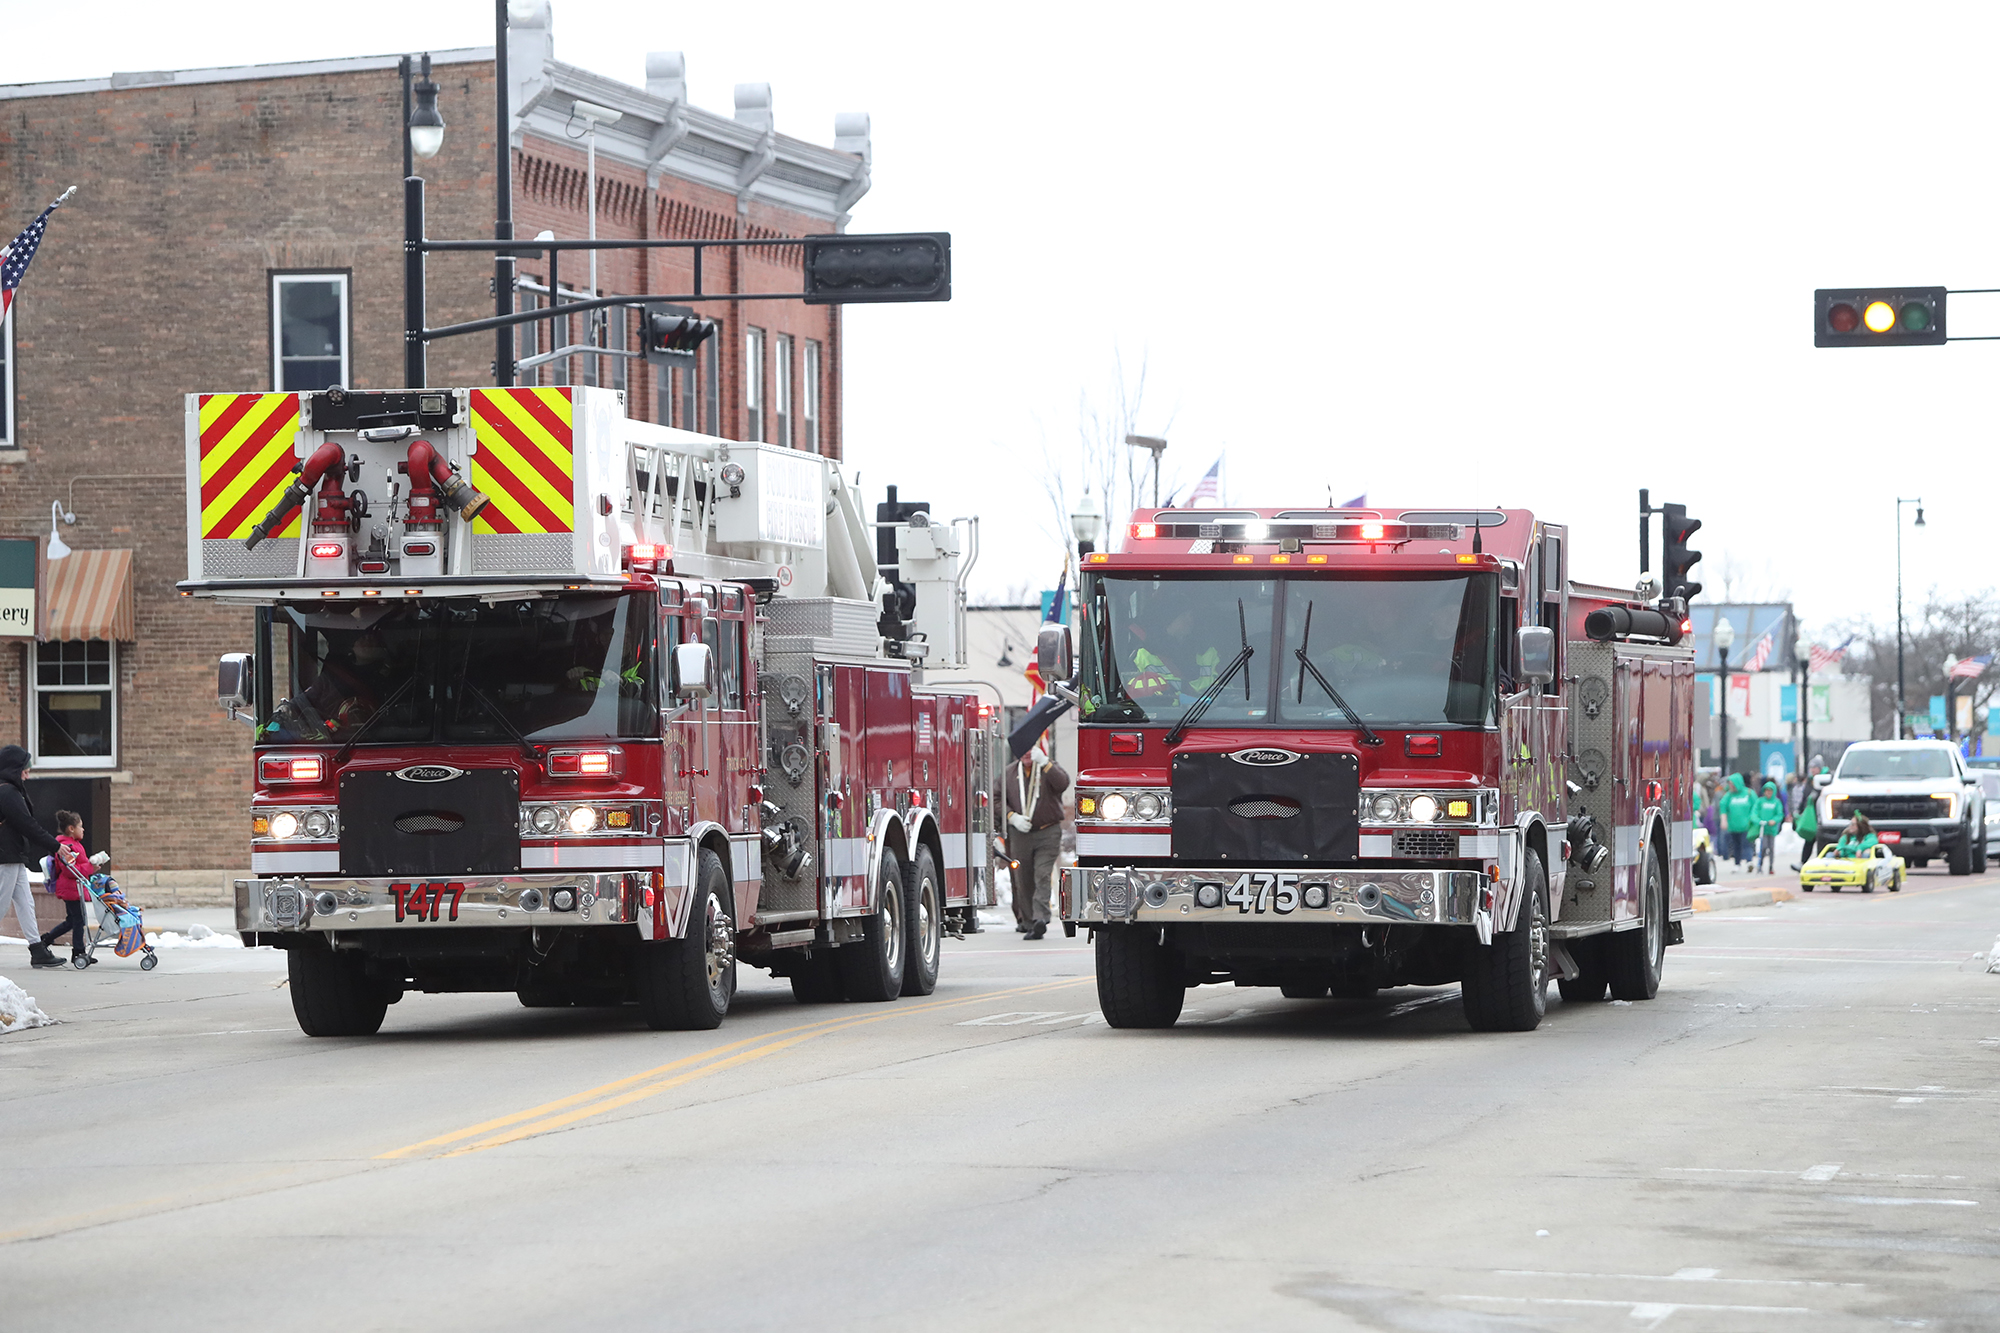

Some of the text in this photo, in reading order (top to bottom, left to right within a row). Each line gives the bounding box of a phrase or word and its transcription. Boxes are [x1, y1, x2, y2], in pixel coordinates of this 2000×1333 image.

[0, 607, 29, 626] ery
[1245, 751, 1284, 762] Pierce
[409, 768, 446, 779] Pierce
[388, 882, 466, 923] T477
[1226, 873, 1300, 915] 475
